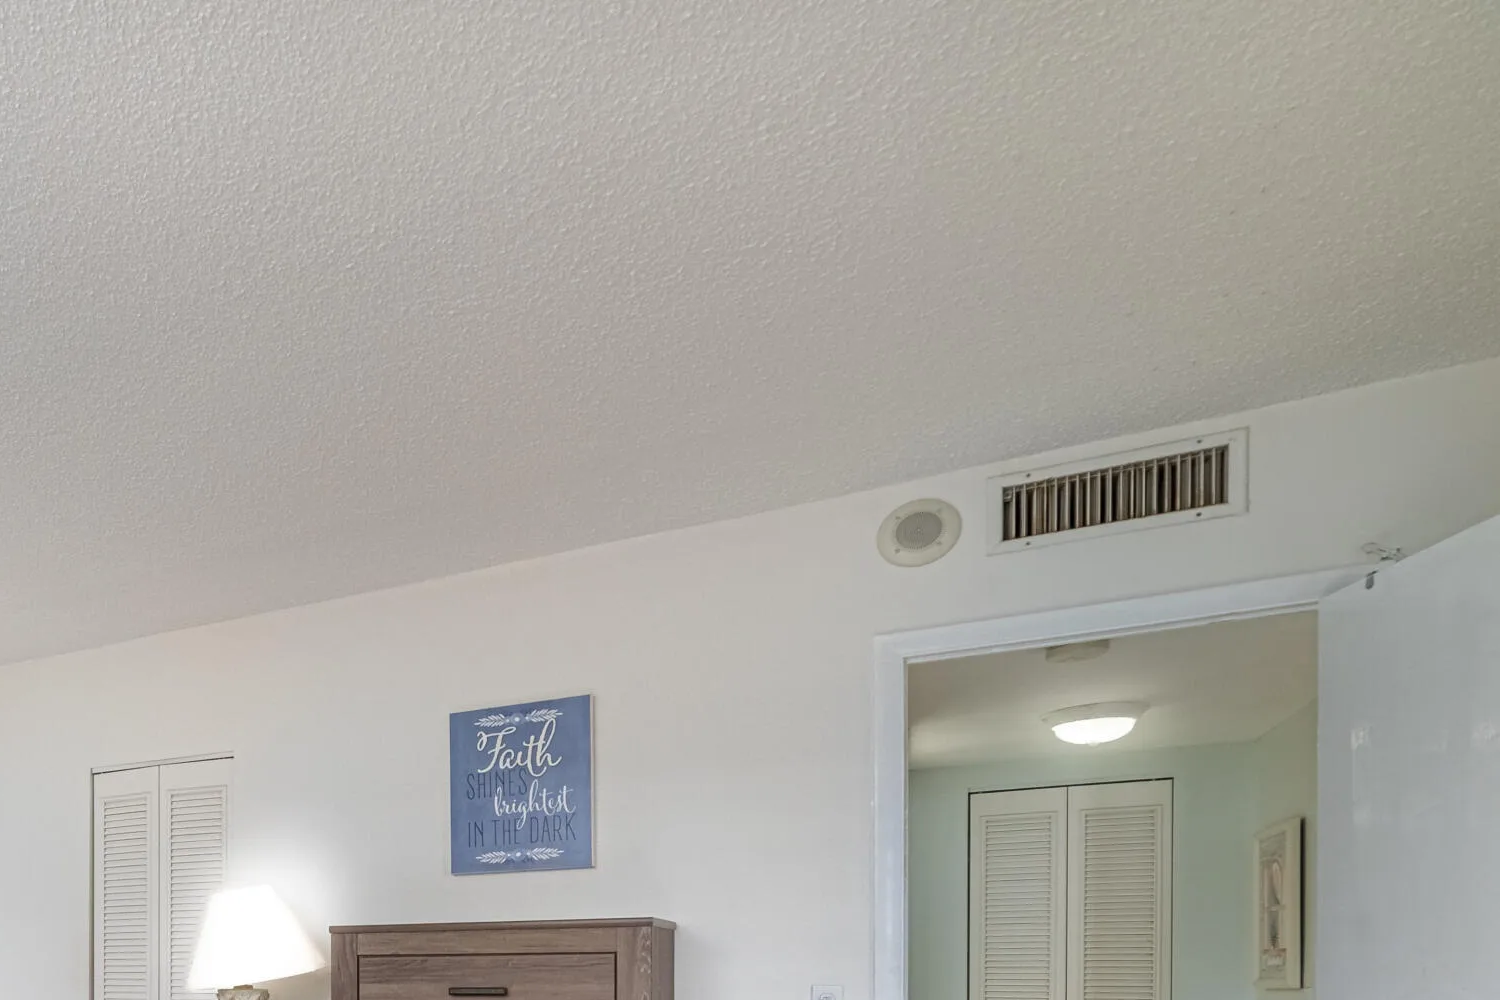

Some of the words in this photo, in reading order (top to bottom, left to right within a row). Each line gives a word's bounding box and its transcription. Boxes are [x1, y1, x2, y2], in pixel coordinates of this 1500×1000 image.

[477, 718, 563, 777] Faith
[466, 768, 528, 800] SHINES
[494, 779, 577, 830] brightest
[467, 820, 485, 848] IN
[491, 818, 520, 846] THE
[529, 813, 577, 844] DARK
